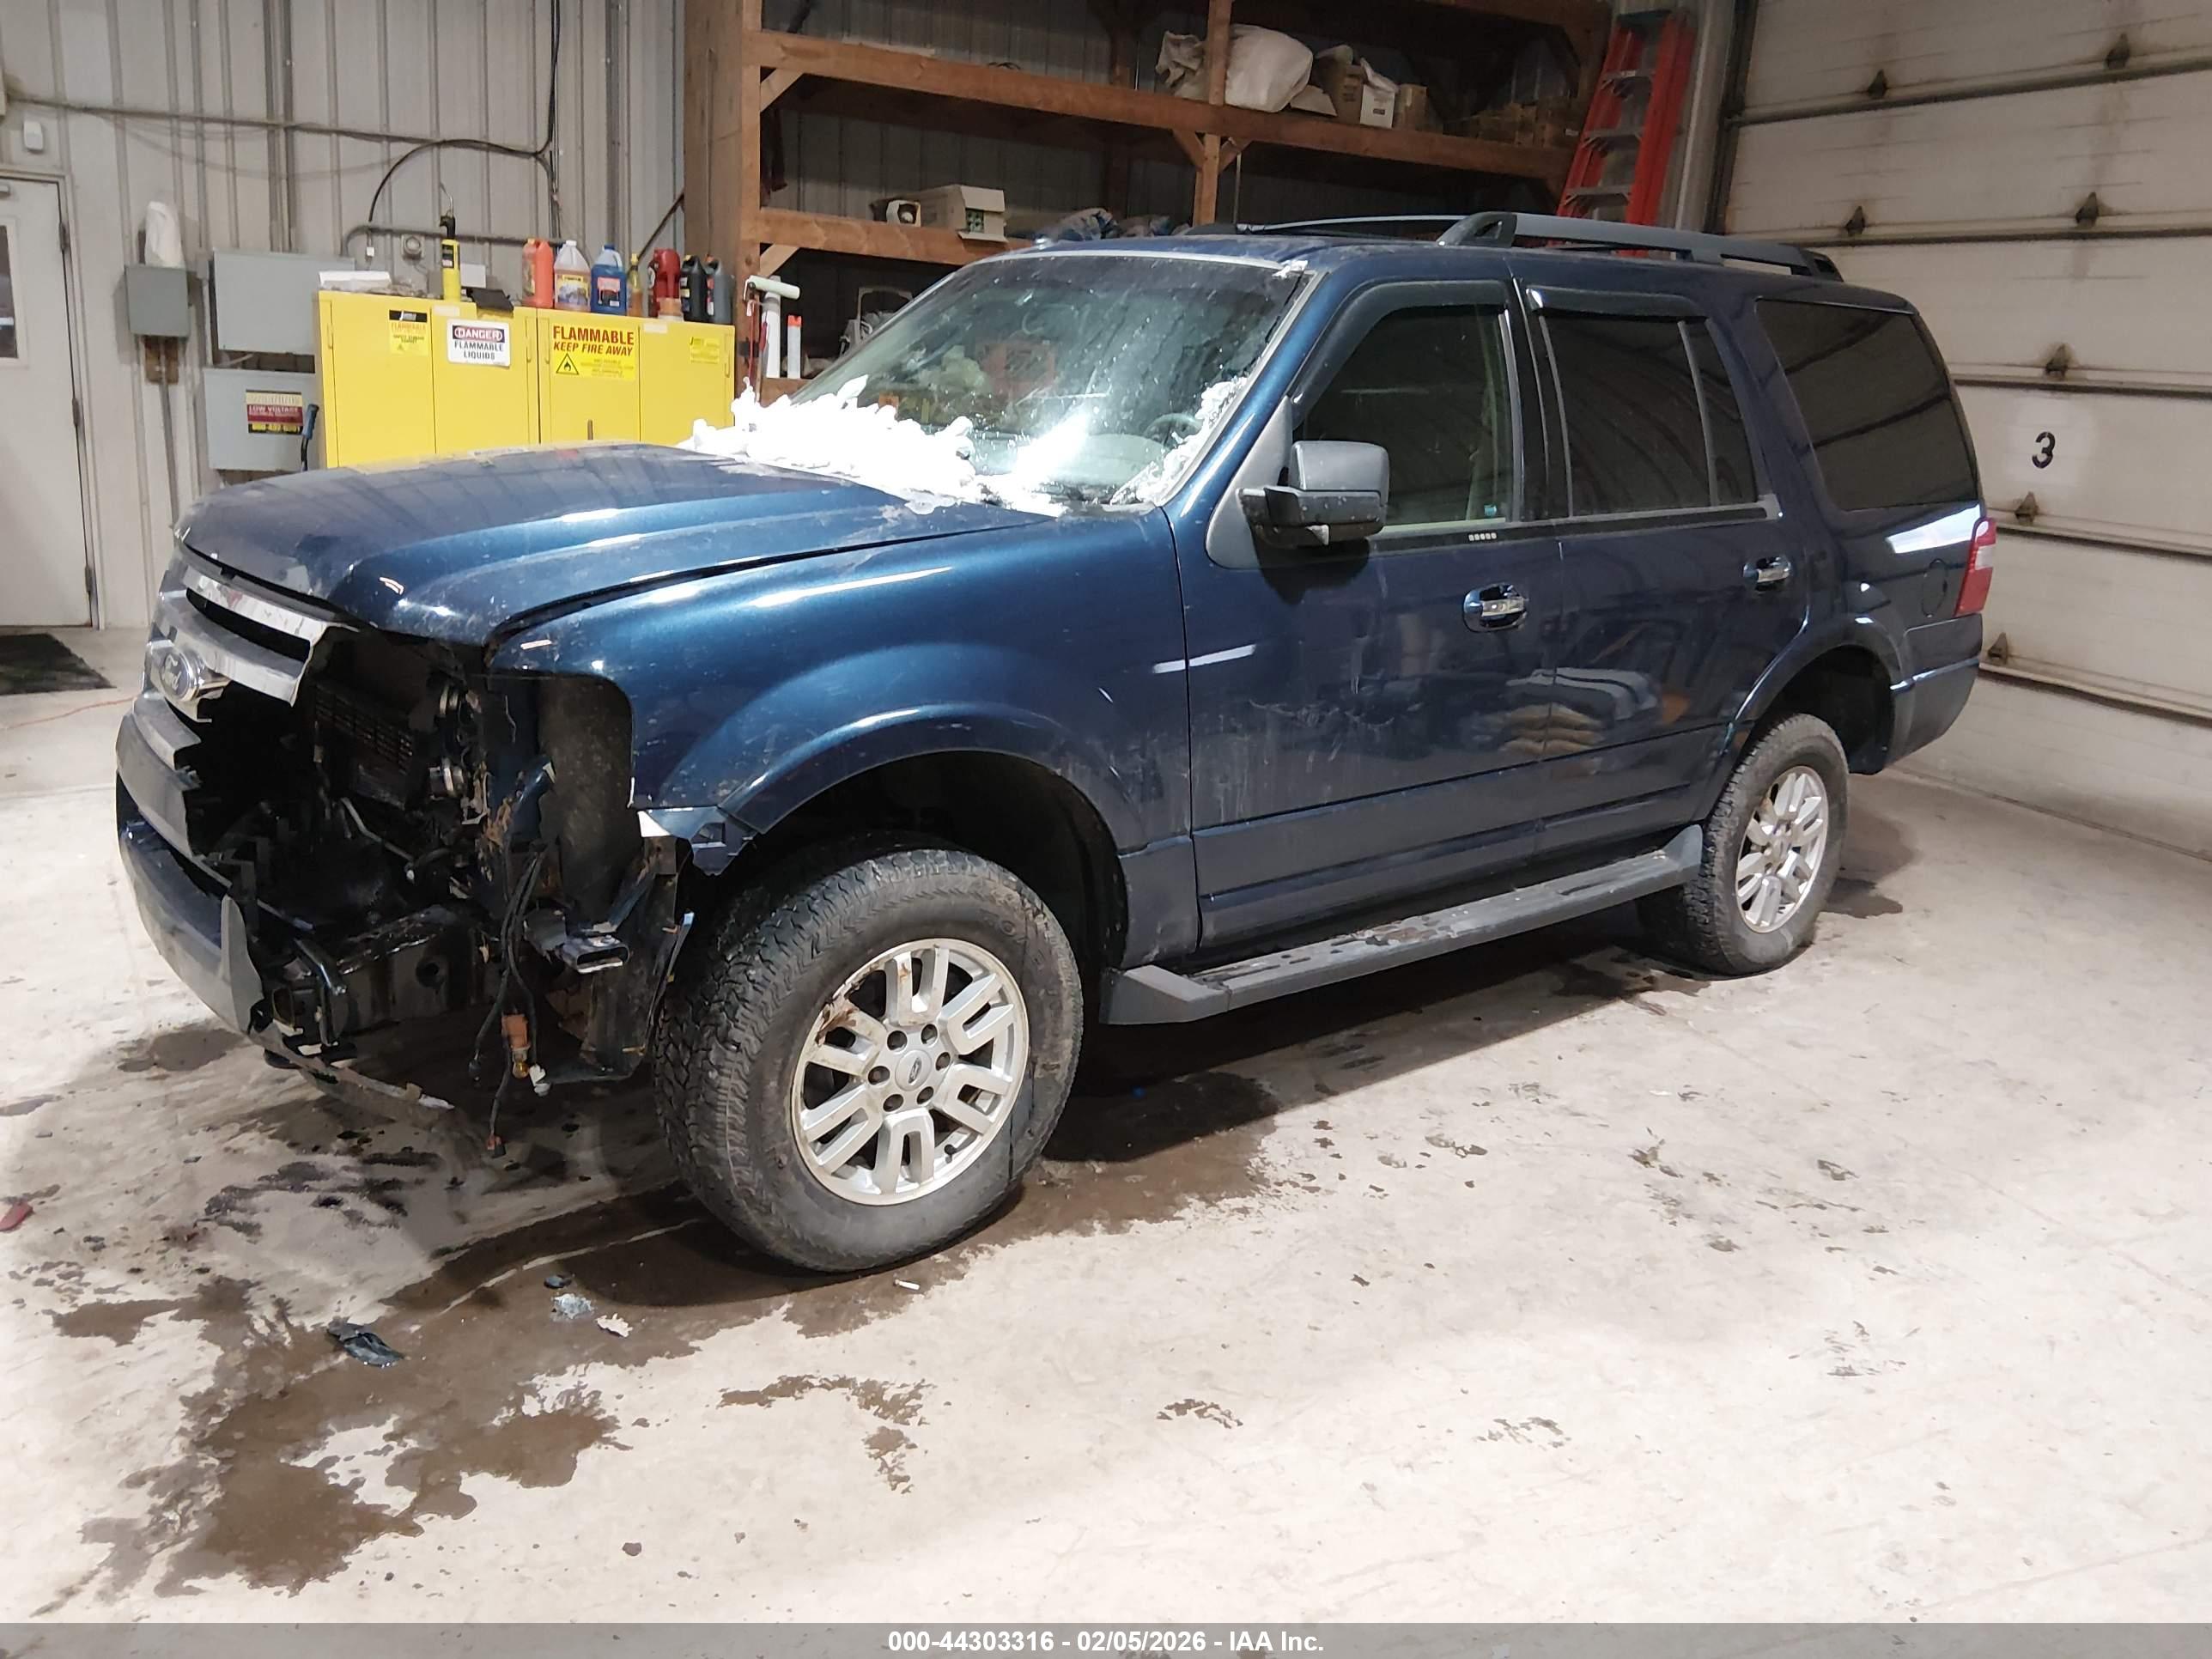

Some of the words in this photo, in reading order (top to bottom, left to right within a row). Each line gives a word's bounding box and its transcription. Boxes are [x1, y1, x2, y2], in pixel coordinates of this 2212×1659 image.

[458, 327, 500, 341] DANGER
[552, 325, 635, 345] FLAMMABLE
[454, 340, 504, 351] FLAMMABLE
[553, 341, 579, 353] KEEP
[581, 343, 603, 355] FIRE
[605, 345, 633, 356] AWAY
[464, 350, 495, 360] LIQUIDS
[2032, 431, 2056, 469] 3
